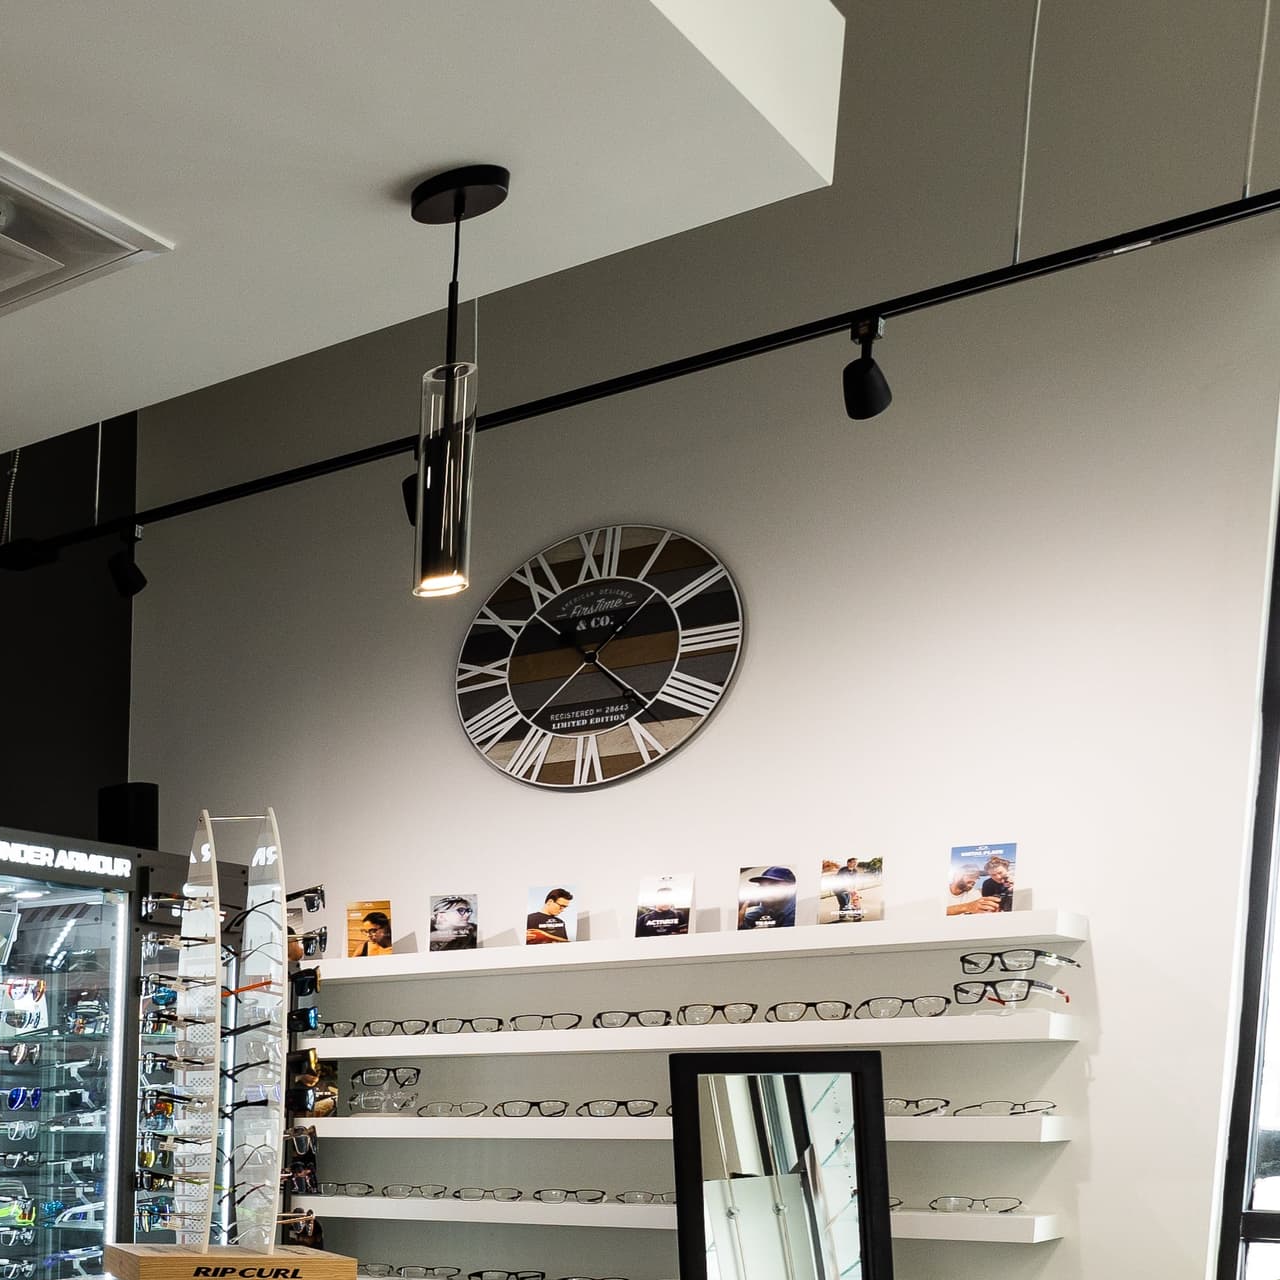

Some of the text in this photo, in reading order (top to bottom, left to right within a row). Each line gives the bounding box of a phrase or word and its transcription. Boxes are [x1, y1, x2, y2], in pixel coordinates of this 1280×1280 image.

[576, 615, 614, 631] & CO.
[550, 709, 595, 721] REGISTERED
[552, 713, 626, 730] LIMITED EDITION
[54, 849, 132, 878] ARMOUR
[193, 1266, 304, 1279] RIP CURL
